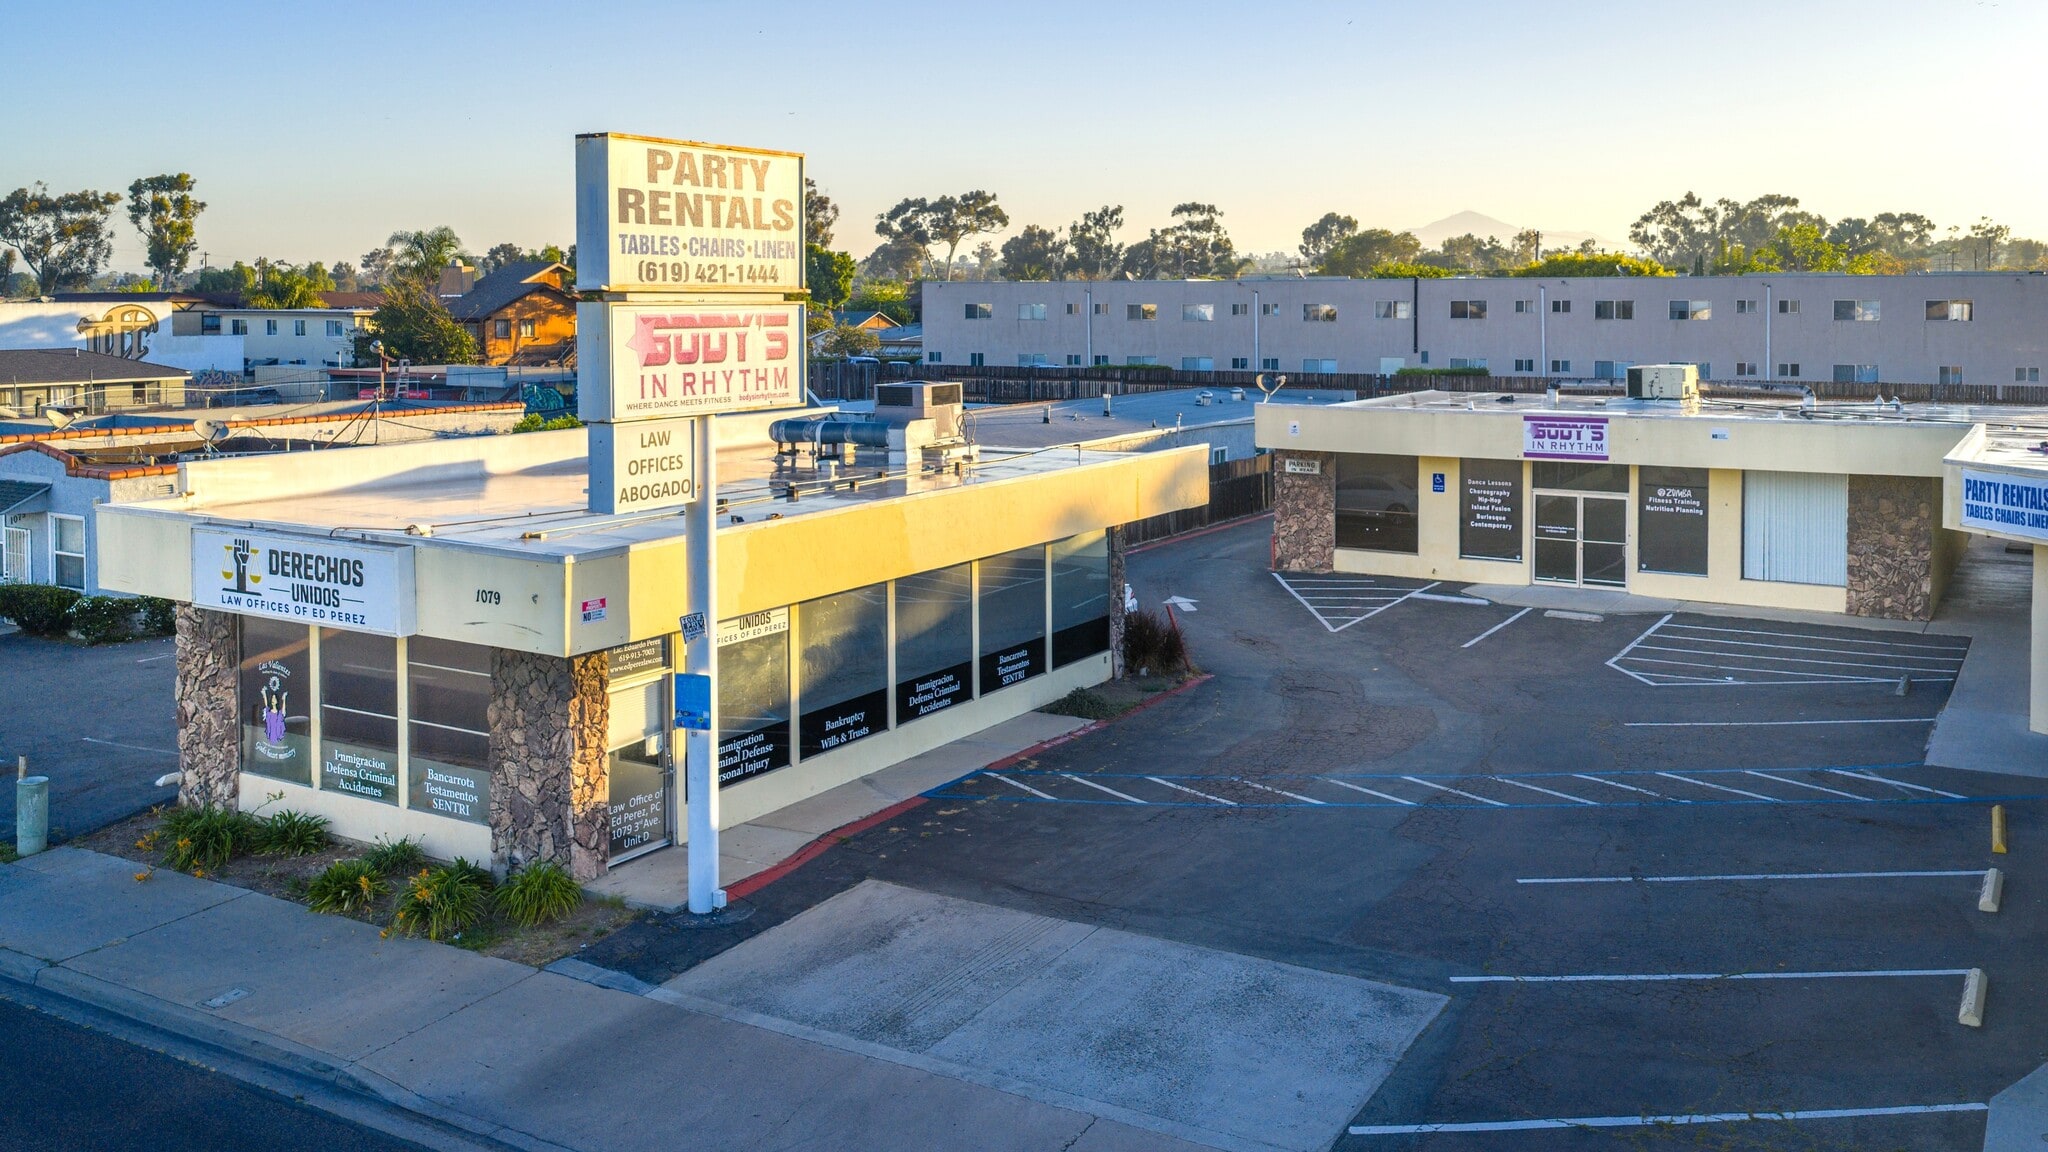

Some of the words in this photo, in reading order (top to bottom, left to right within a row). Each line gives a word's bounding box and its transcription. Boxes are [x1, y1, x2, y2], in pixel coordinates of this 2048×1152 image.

[646, 148, 770, 192] PARTY
[618, 188, 794, 231] RENTALS
[618, 234, 680, 256] TABLES
[688, 236, 746, 258] CHAIRS
[754, 240, 796, 260] LINEN
[638, 260, 690, 282] (619)
[695, 264, 779, 284] 421-1444
[640, 374, 667, 399] IN
[682, 366, 788, 396] RHYTHM
[626, 401, 652, 410] WHERE
[654, 399, 678, 409] DANCE
[680, 398, 702, 407] MEETS
[704, 396, 732, 405] FITNESS
[640, 430, 671, 448] LAW
[1532, 441, 1544, 450] IN
[1550, 442, 1604, 452] RHYTHM
[628, 454, 684, 476] OFFICES
[1288, 460, 1316, 468] PARKING
[619, 479, 691, 504] ABOGADO
[1470, 488, 1510, 497] Choreography
[1478, 496, 1501, 504] Hip-Hop
[1674, 498, 1700, 506] Training
[1965, 478, 2000, 504] PARTY
[2002, 483, 2048, 511] RENTALS
[1676, 507, 1703, 515] Planning
[1965, 504, 1993, 521] TABLES
[1995, 508, 2025, 526] CHAIRS
[1470, 521, 1512, 530] Contemporary
[268, 549, 364, 587] DERECHOS
[291, 583, 340, 608] UNIDOS
[476, 589, 500, 605] 1079
[221, 595, 242, 606] LAW
[247, 598, 289, 613] OFFICES
[294, 605, 307, 616] OF
[312, 608, 326, 619] ED
[331, 611, 366, 625] PEREZ
[583, 612, 592, 622] NO
[740, 612, 771, 630] UNIDOS
[717, 634, 737, 644] FICES
[741, 630, 750, 638] OF
[753, 626, 762, 636] ED
[765, 622, 786, 633] PEREZ
[619, 648, 655, 662] 619-913-7003
[624, 641, 646, 651] Eduardo
[647, 639, 660, 647] Perez
[997, 659, 1030, 676] Testamentos
[999, 650, 1028, 664] Bancarrota
[916, 674, 954, 692] Immigracion
[1002, 670, 1025, 685] SENTRI
[909, 692, 933, 707] Defensa
[934, 681, 960, 698] Criminal
[919, 698, 951, 715] Accidentes
[825, 711, 865, 732] Bankruptcy
[718, 733, 764, 754] mmigration
[821, 738, 839, 750] Wills
[840, 734, 846, 743] &
[848, 726, 869, 740] Trusts
[335, 749, 386, 770] Immigracion
[718, 748, 740, 768] minal
[742, 743, 774, 760] Defense
[326, 762, 357, 778] Defensa
[359, 768, 395, 786] Criminal
[428, 768, 474, 788] Bancarrota
[719, 763, 743, 782] rsonal
[745, 758, 770, 774] Injury
[338, 779, 382, 797] Accidentes
[424, 782, 478, 803] Testamentos
[432, 798, 470, 816] SENTRI
[608, 803, 625, 815] Law
[630, 794, 653, 807] Office
[655, 787, 664, 799] of
[611, 814, 621, 827] Ed
[624, 808, 648, 822] Perez,
[651, 802, 661, 813] PC
[612, 824, 632, 840] 1079
[643, 817, 660, 828] Ave.
[624, 834, 641, 848] Unit
[643, 831, 649, 841] D
